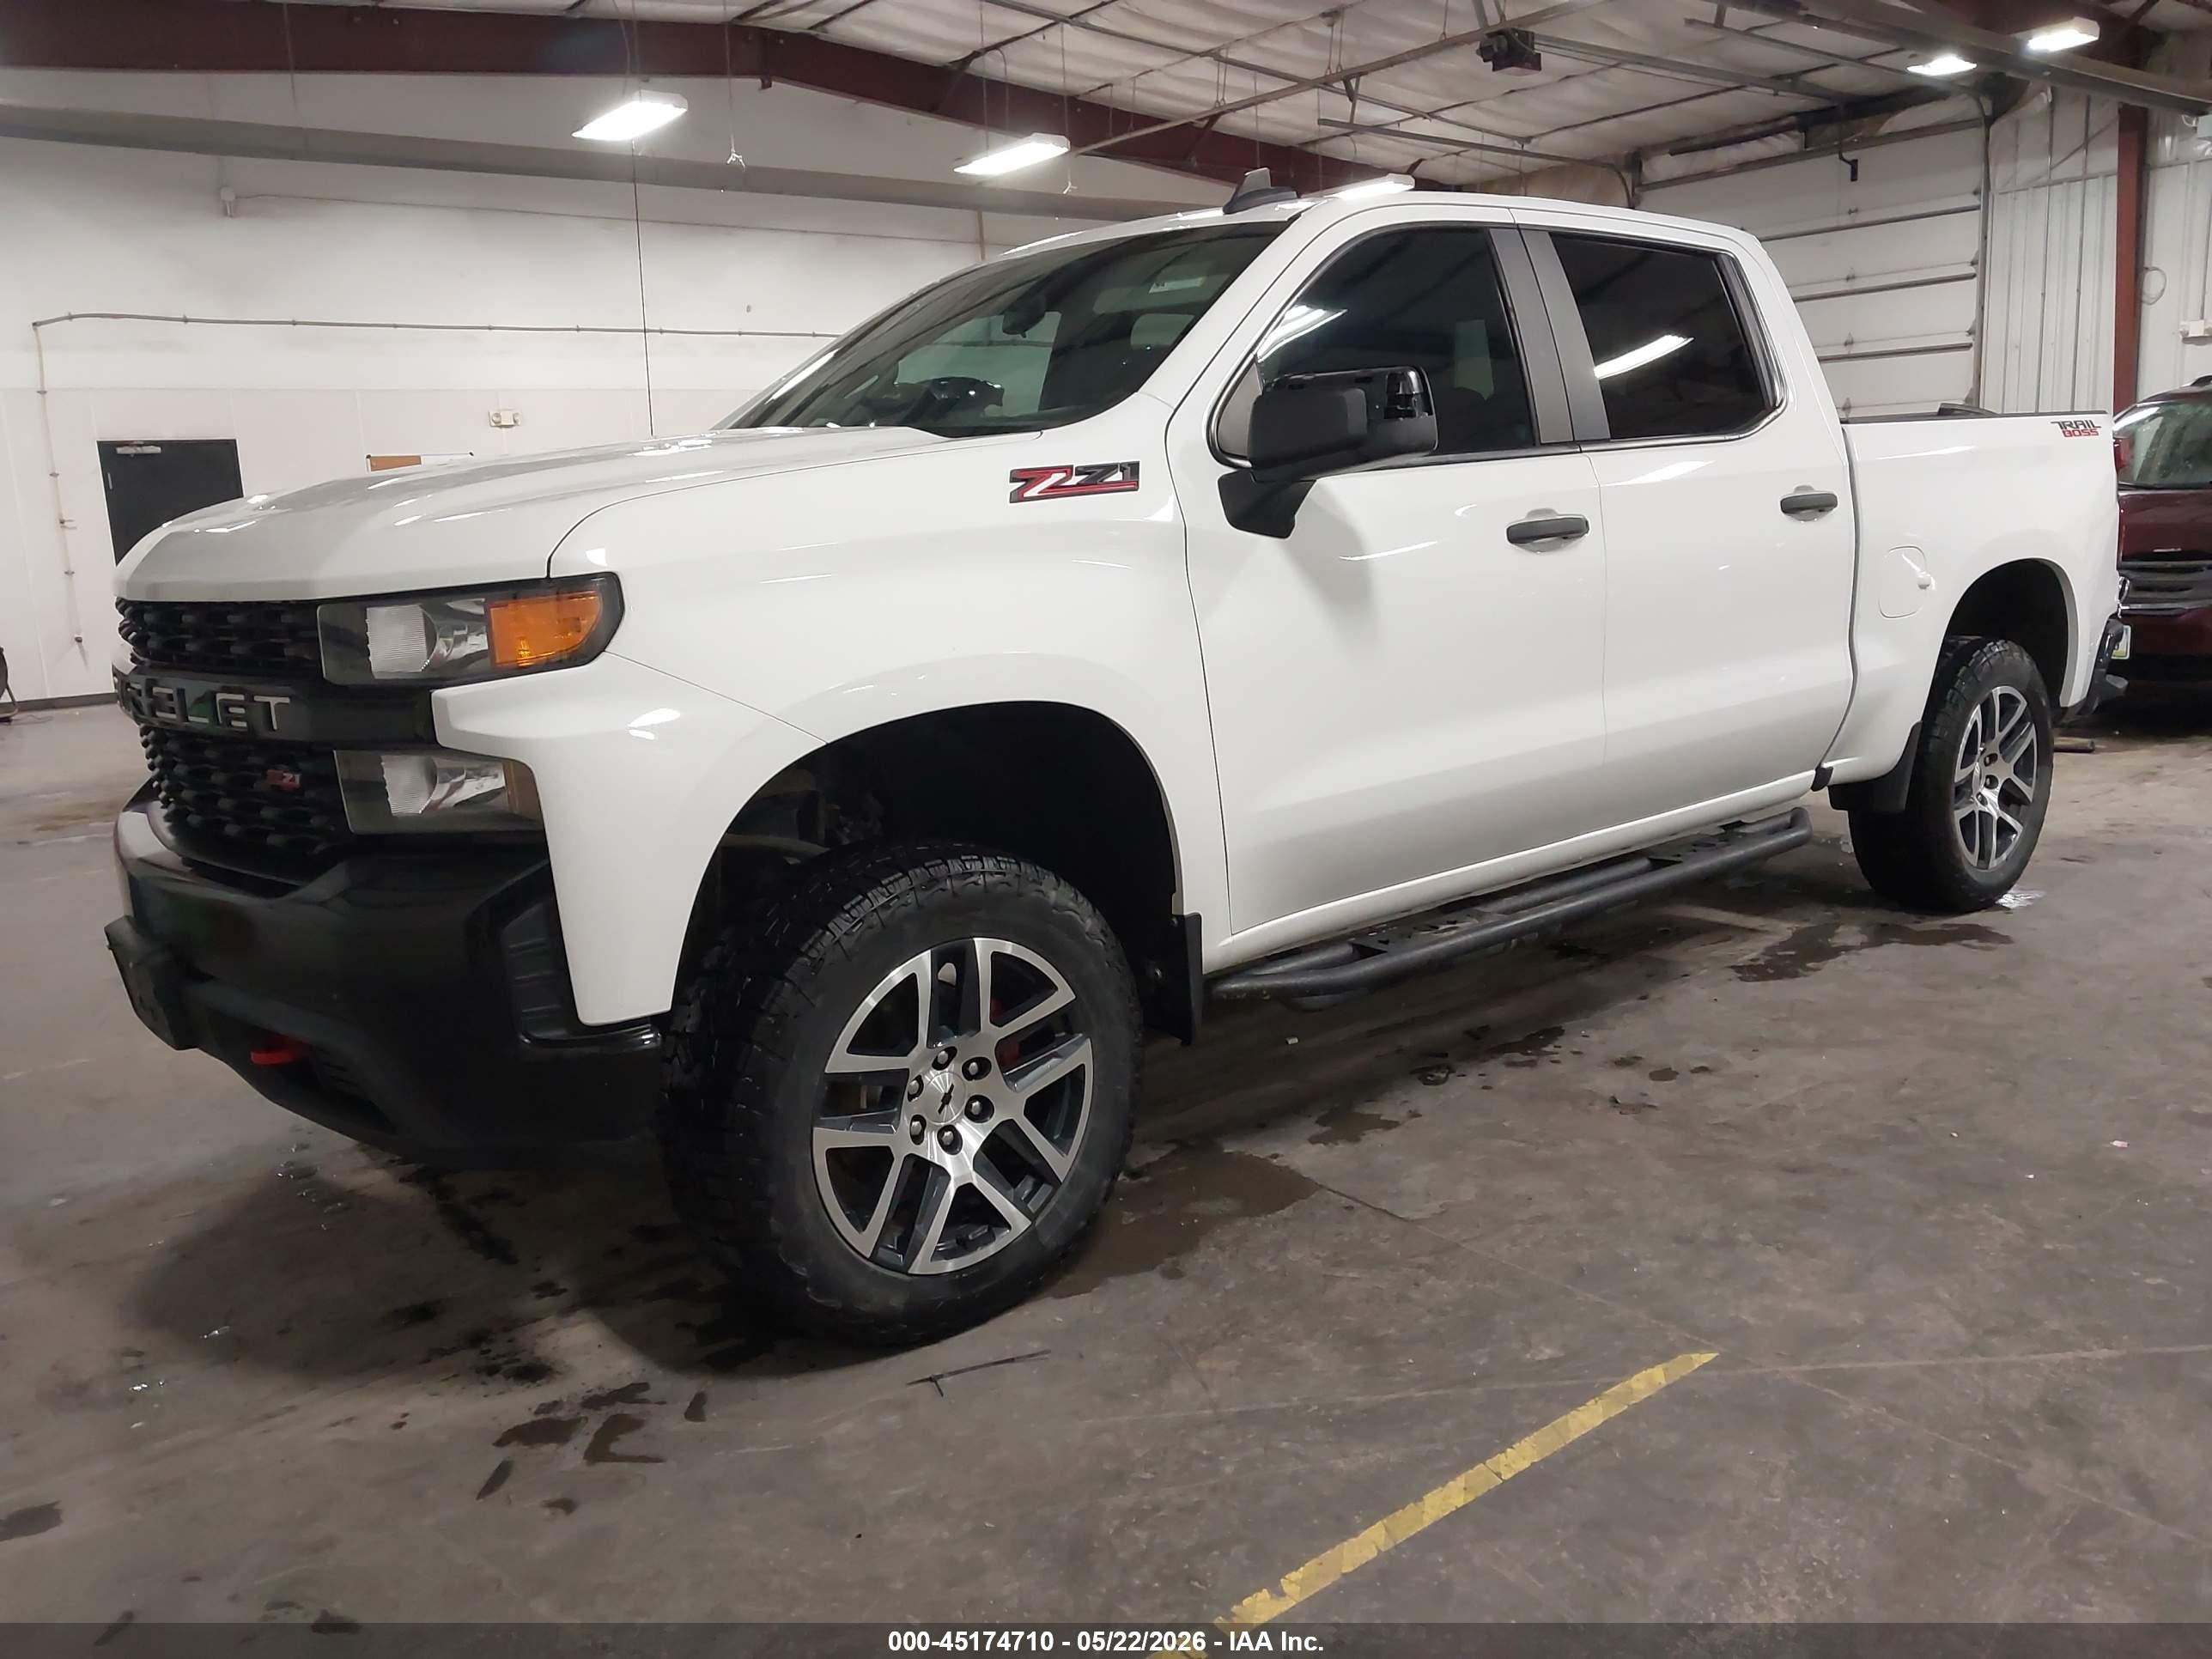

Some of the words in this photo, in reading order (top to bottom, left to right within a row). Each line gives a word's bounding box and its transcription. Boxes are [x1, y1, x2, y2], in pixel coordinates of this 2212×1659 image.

[2051, 419, 2102, 430] TRAIL
[2062, 428, 2100, 438] BOSS
[1009, 460, 1140, 503] Z71
